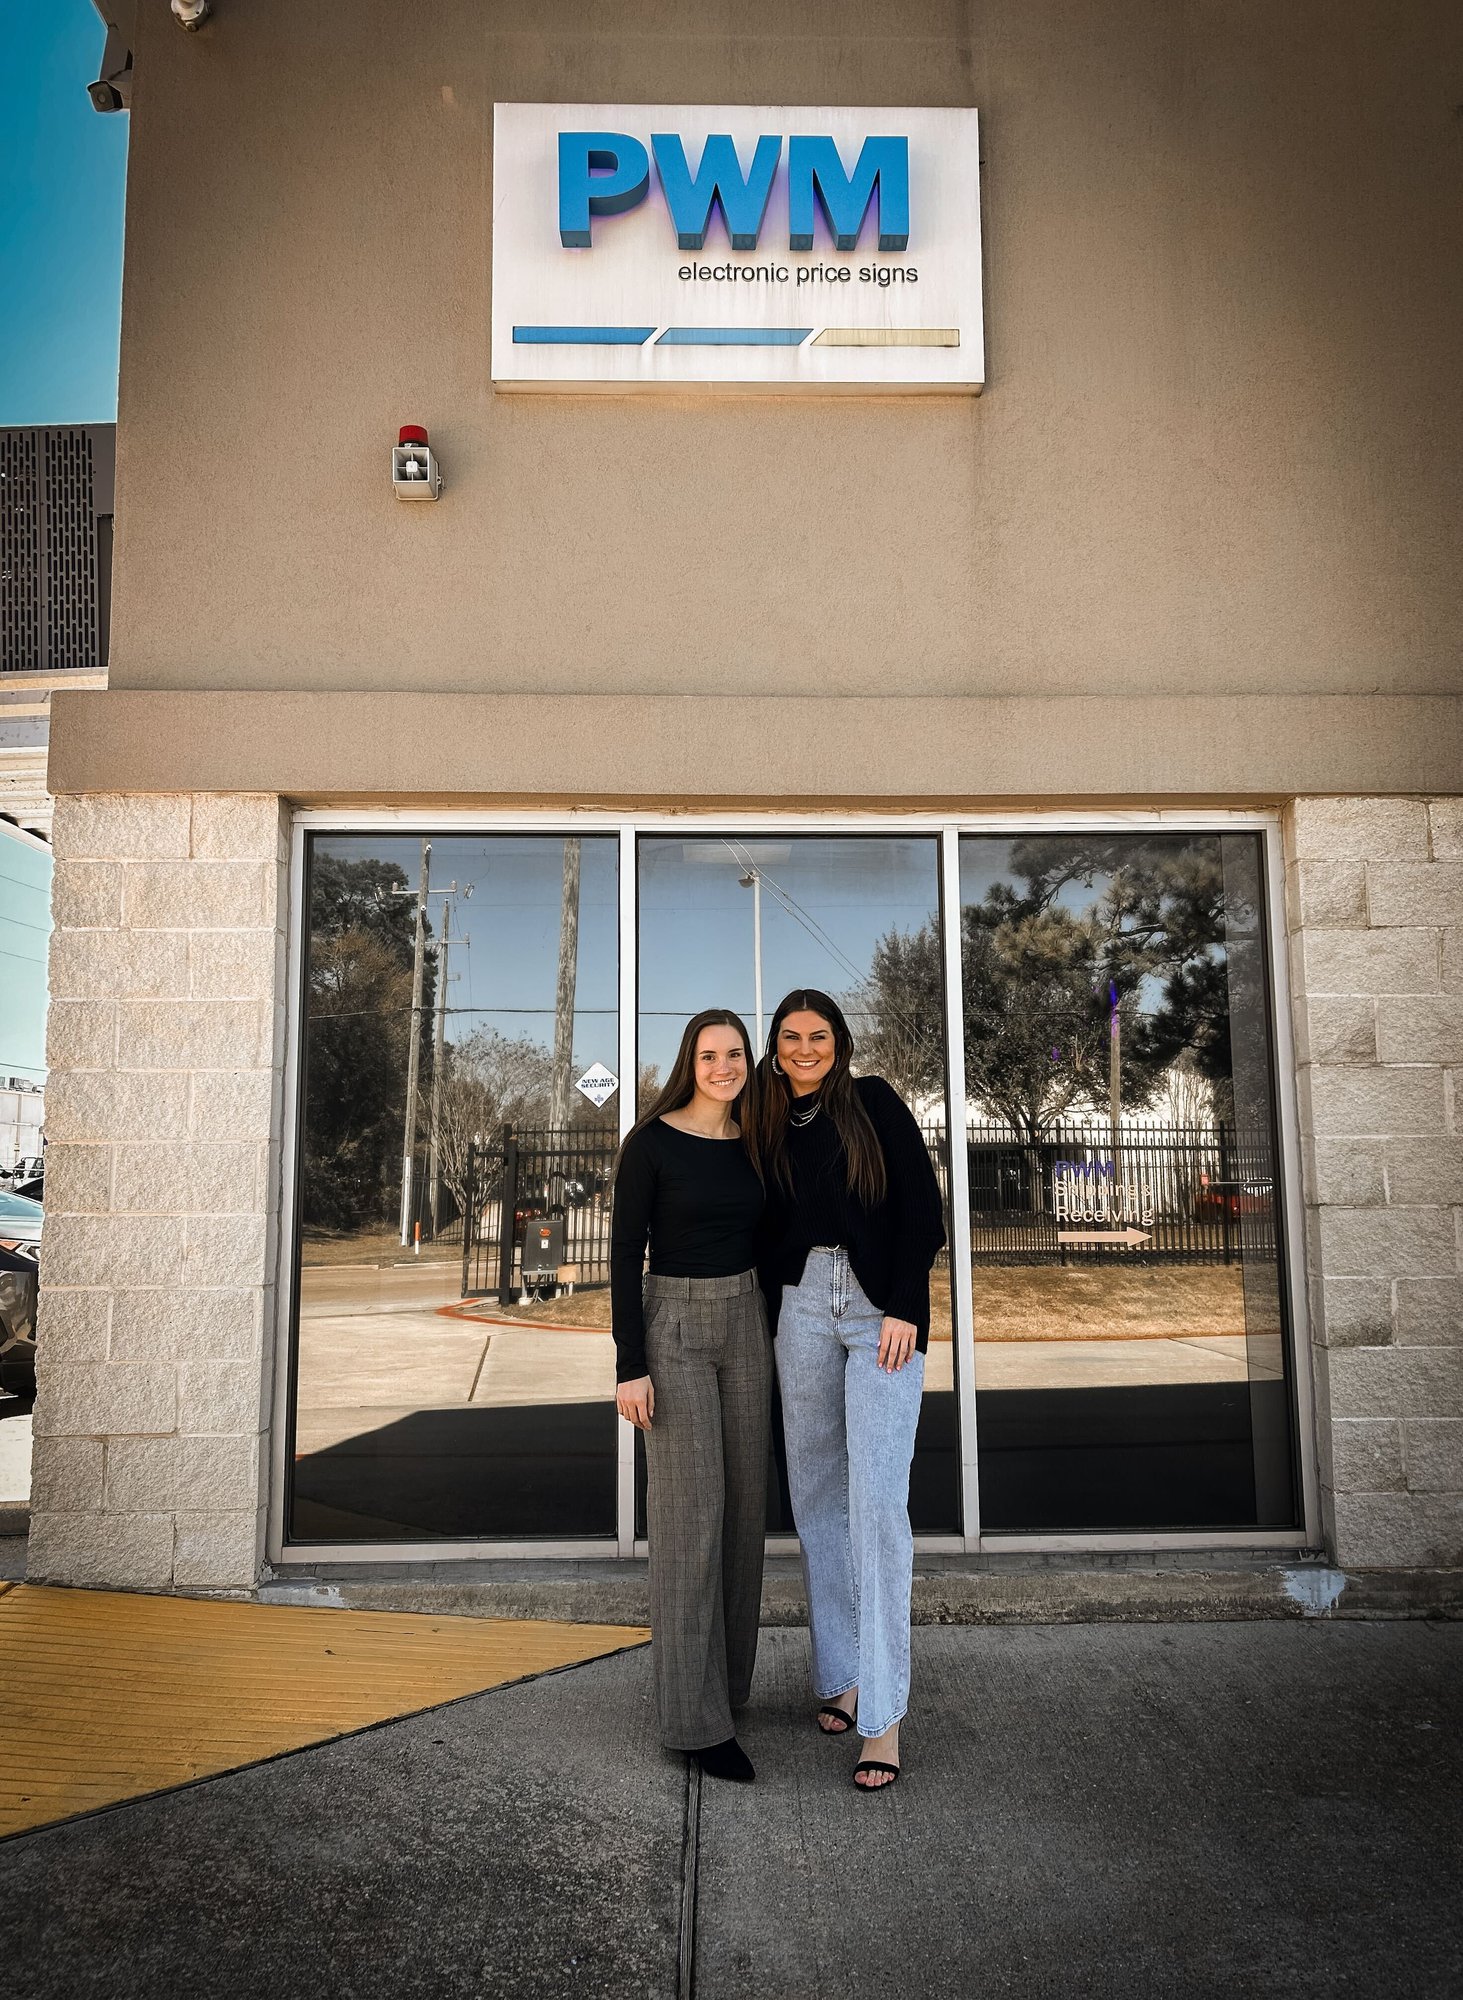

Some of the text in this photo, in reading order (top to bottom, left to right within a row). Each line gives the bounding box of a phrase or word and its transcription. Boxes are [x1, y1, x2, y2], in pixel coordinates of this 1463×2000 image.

[558, 131, 909, 252] PWM
[678, 262, 919, 288] electronic price signs
[1055, 1160, 1115, 1180] PWM
[1054, 1180, 1137, 1200] Shipping
[1056, 1206, 1154, 1226] Receiving
